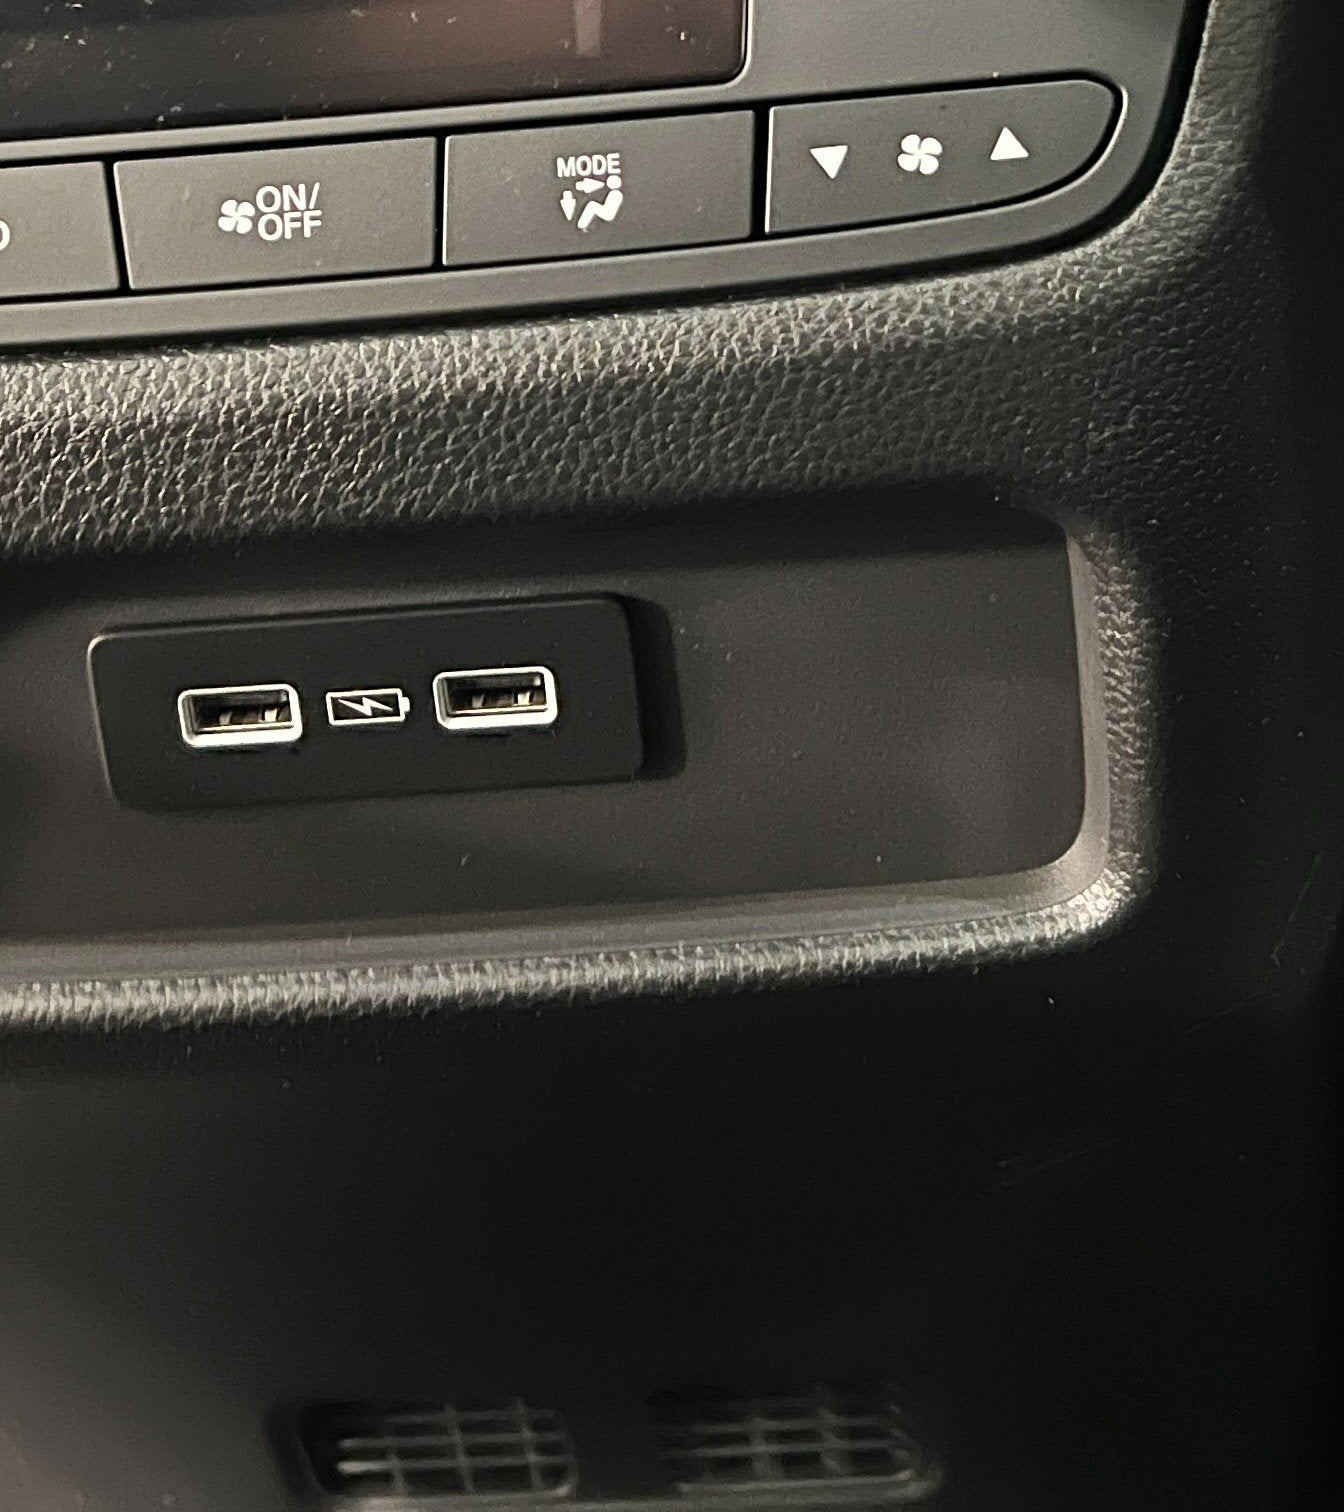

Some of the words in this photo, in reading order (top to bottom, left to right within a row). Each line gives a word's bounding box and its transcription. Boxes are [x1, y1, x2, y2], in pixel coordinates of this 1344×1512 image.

[556, 152, 622, 178] MODE
[255, 181, 321, 213] ON/
[257, 209, 323, 241] OFF
